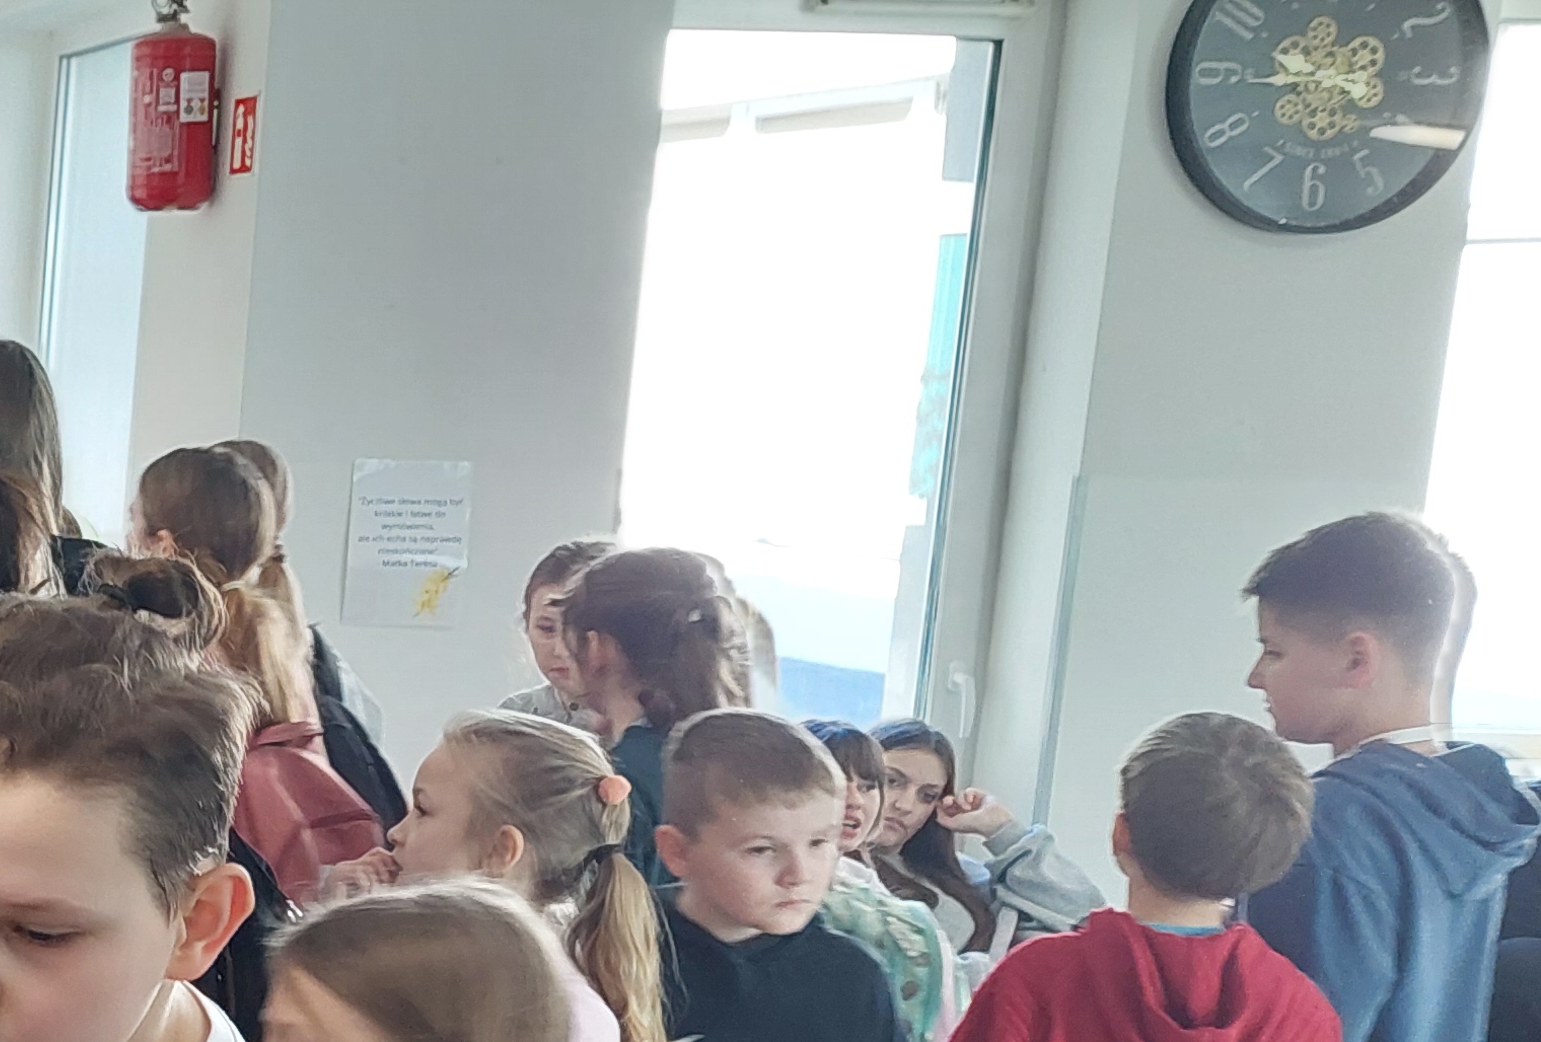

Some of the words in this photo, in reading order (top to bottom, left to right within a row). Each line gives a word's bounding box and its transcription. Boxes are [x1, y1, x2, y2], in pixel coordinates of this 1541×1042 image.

[1203, 112, 1250, 149] 8
[1243, 145, 1285, 193] 7
[1300, 162, 1327, 212] 6
